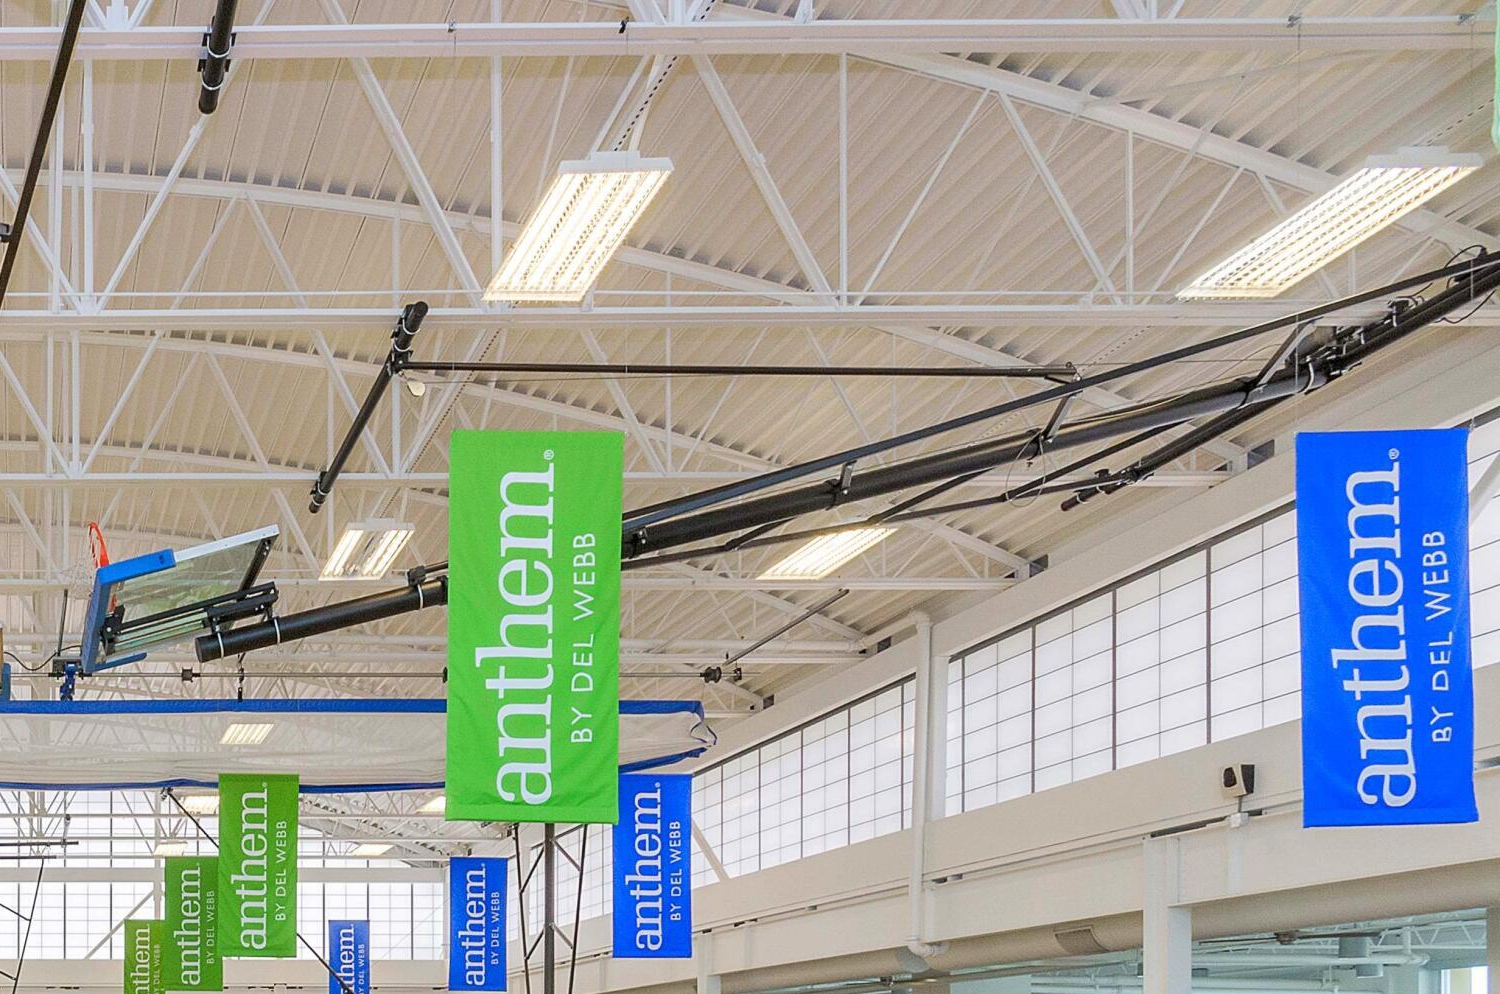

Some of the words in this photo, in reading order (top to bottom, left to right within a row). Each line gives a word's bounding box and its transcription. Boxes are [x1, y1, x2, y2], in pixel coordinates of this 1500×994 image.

[573, 533, 596, 621] WEBB
[1422, 531, 1452, 621] WEBB
[571, 634, 594, 692] DEL
[1428, 631, 1453, 691] DEL
[571, 707, 593, 743] BY
[1430, 706, 1454, 742] BY
[276, 820, 287, 864] WEBB
[669, 821, 682, 864] WEBB
[275, 869, 286, 897] DEL
[670, 869, 682, 897] DEL
[206, 890, 215, 922] WEBB
[275, 904, 286, 921] BY
[491, 891, 500, 923] WEBB
[669, 903, 682, 921] BY
[206, 926, 215, 947] DEL
[491, 927, 500, 947] DEL
[206, 950, 214, 964] BY
[491, 951, 499, 965] BY
